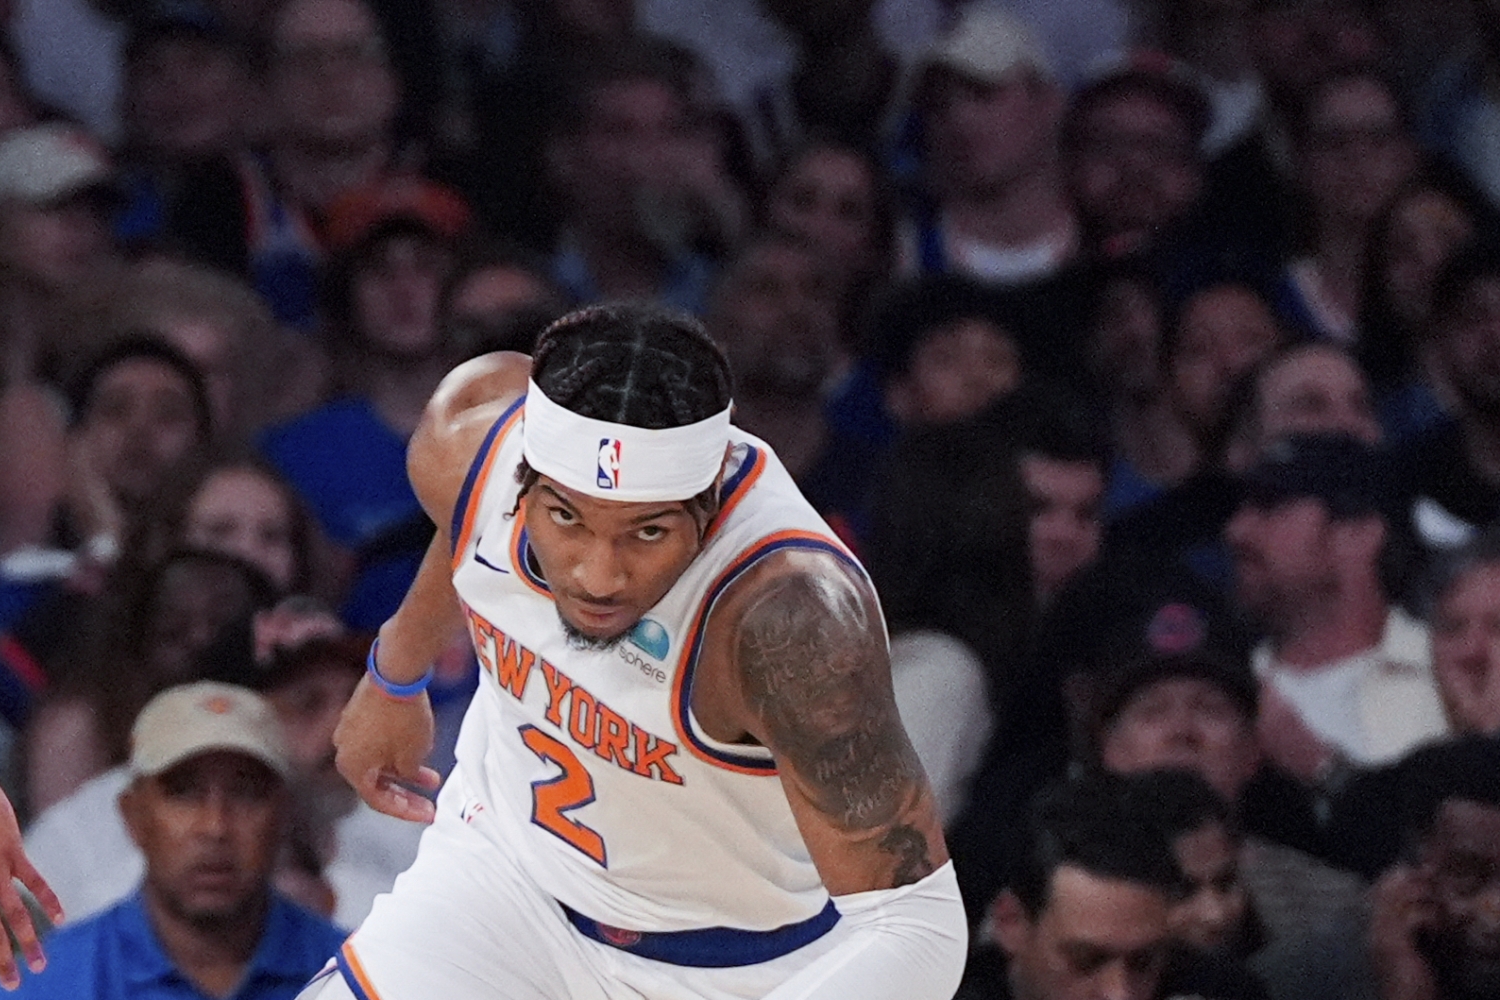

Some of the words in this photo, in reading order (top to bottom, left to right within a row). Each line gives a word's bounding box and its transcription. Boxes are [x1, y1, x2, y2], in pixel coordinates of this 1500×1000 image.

[462, 599, 536, 701] EW
[540, 657, 685, 786] YORK
[619, 645, 667, 684] sphere
[517, 723, 609, 870] 2
